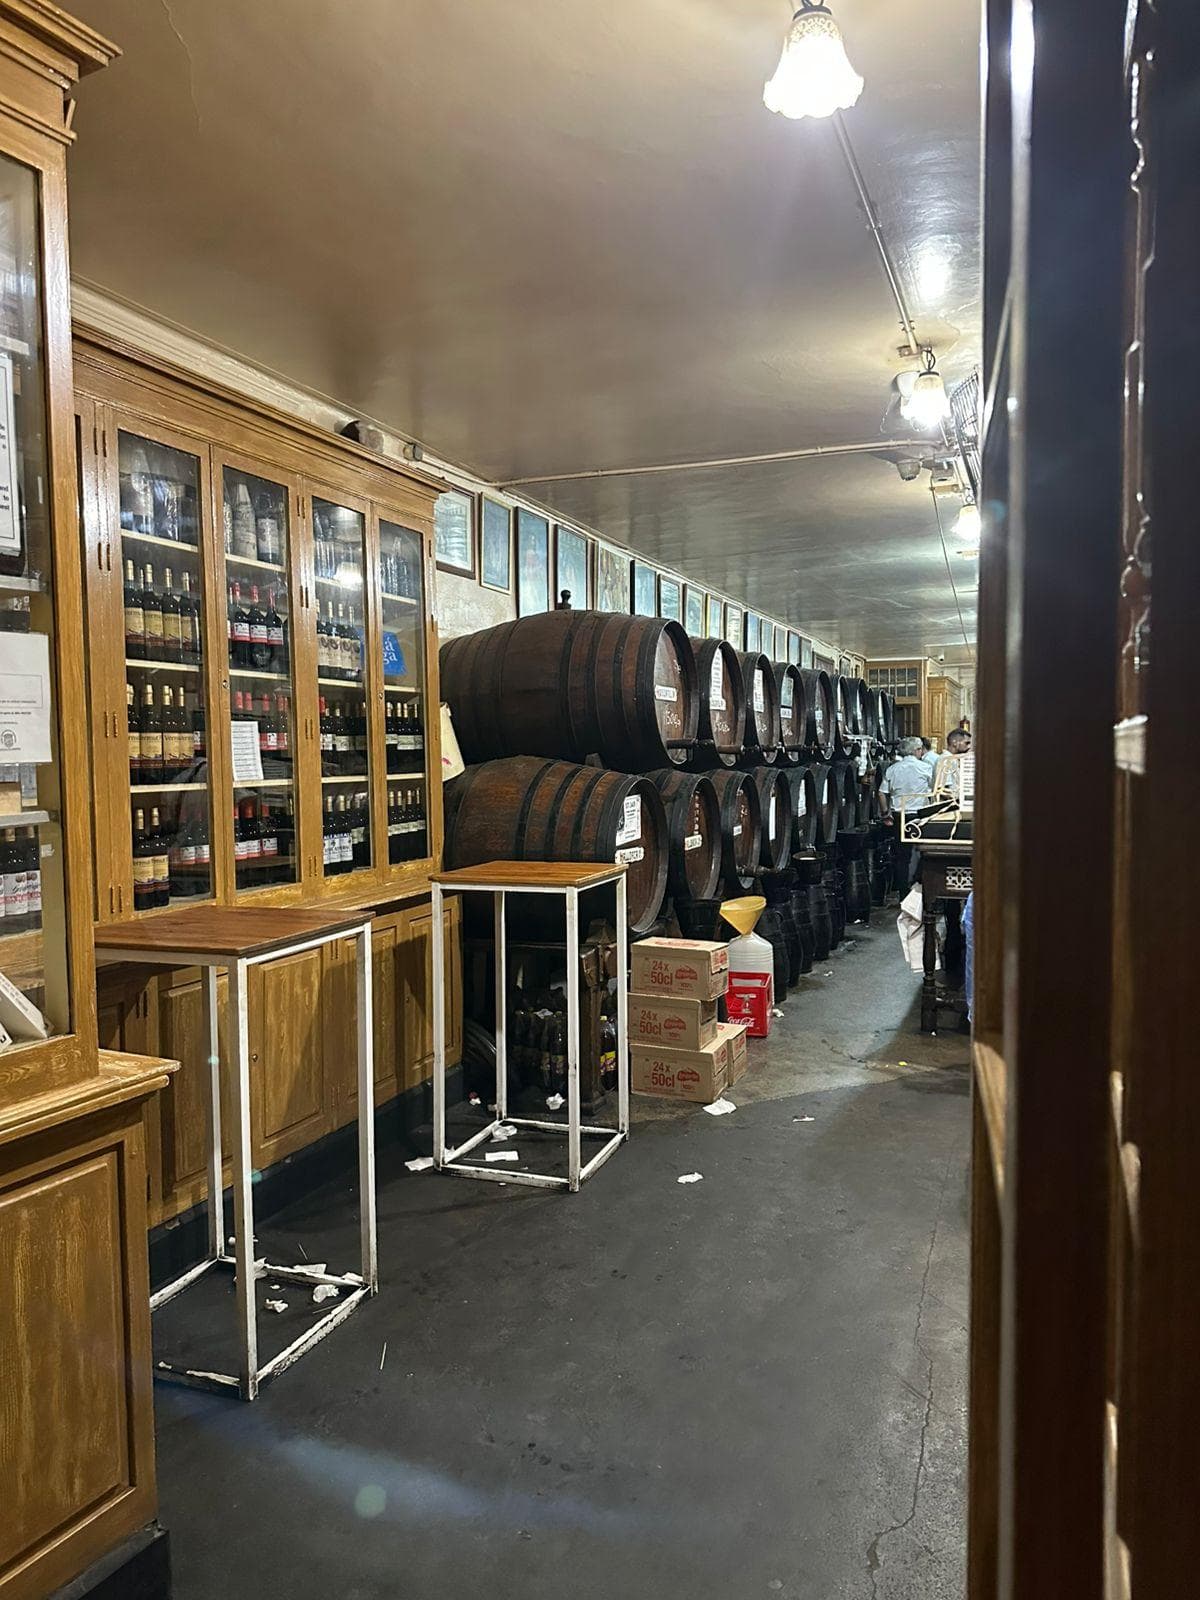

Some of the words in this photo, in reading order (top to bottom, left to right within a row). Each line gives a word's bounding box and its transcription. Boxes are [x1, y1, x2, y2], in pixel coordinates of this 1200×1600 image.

[650, 971, 674, 986] 50cl
[639, 1020, 662, 1036] 50cl
[651, 1072, 675, 1089] 50cl
